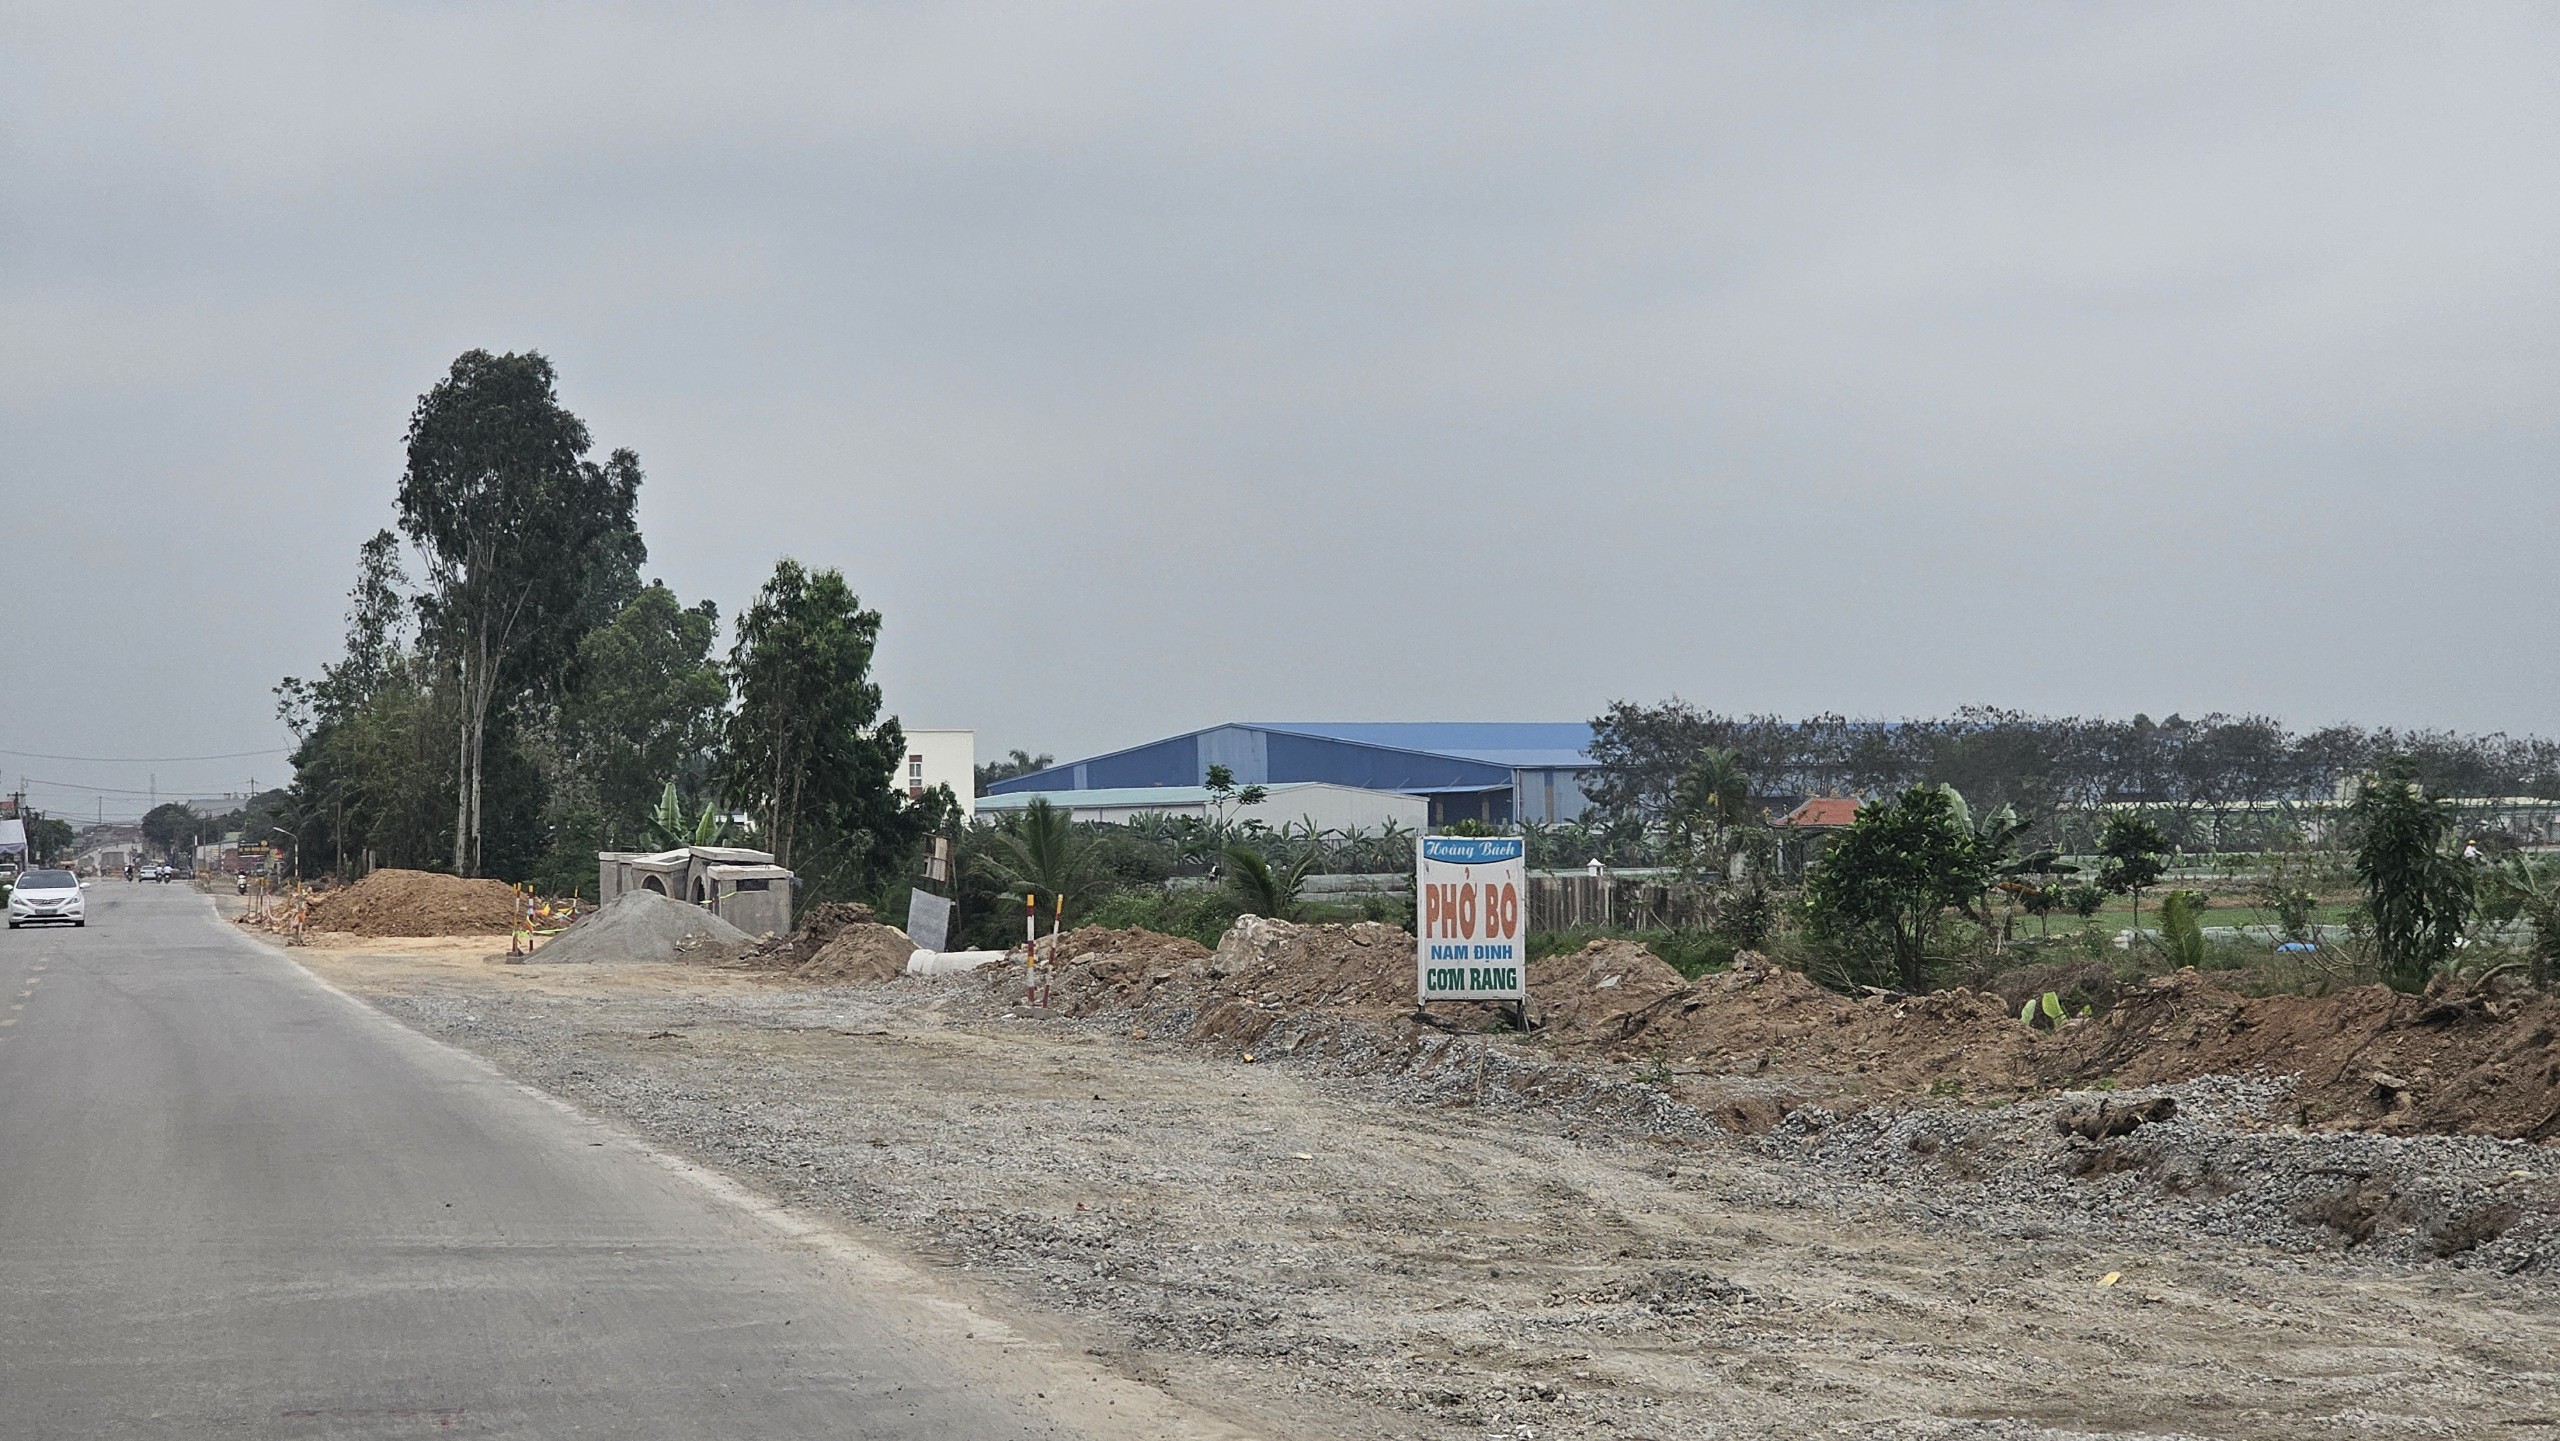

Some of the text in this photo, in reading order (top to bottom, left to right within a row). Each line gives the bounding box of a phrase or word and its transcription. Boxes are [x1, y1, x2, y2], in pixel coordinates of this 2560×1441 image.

[1425, 867, 1518, 940] PHỞ BÒ
[1431, 945, 1513, 963] NAM ĐỊNH
[1470, 967, 1518, 991] RANG
